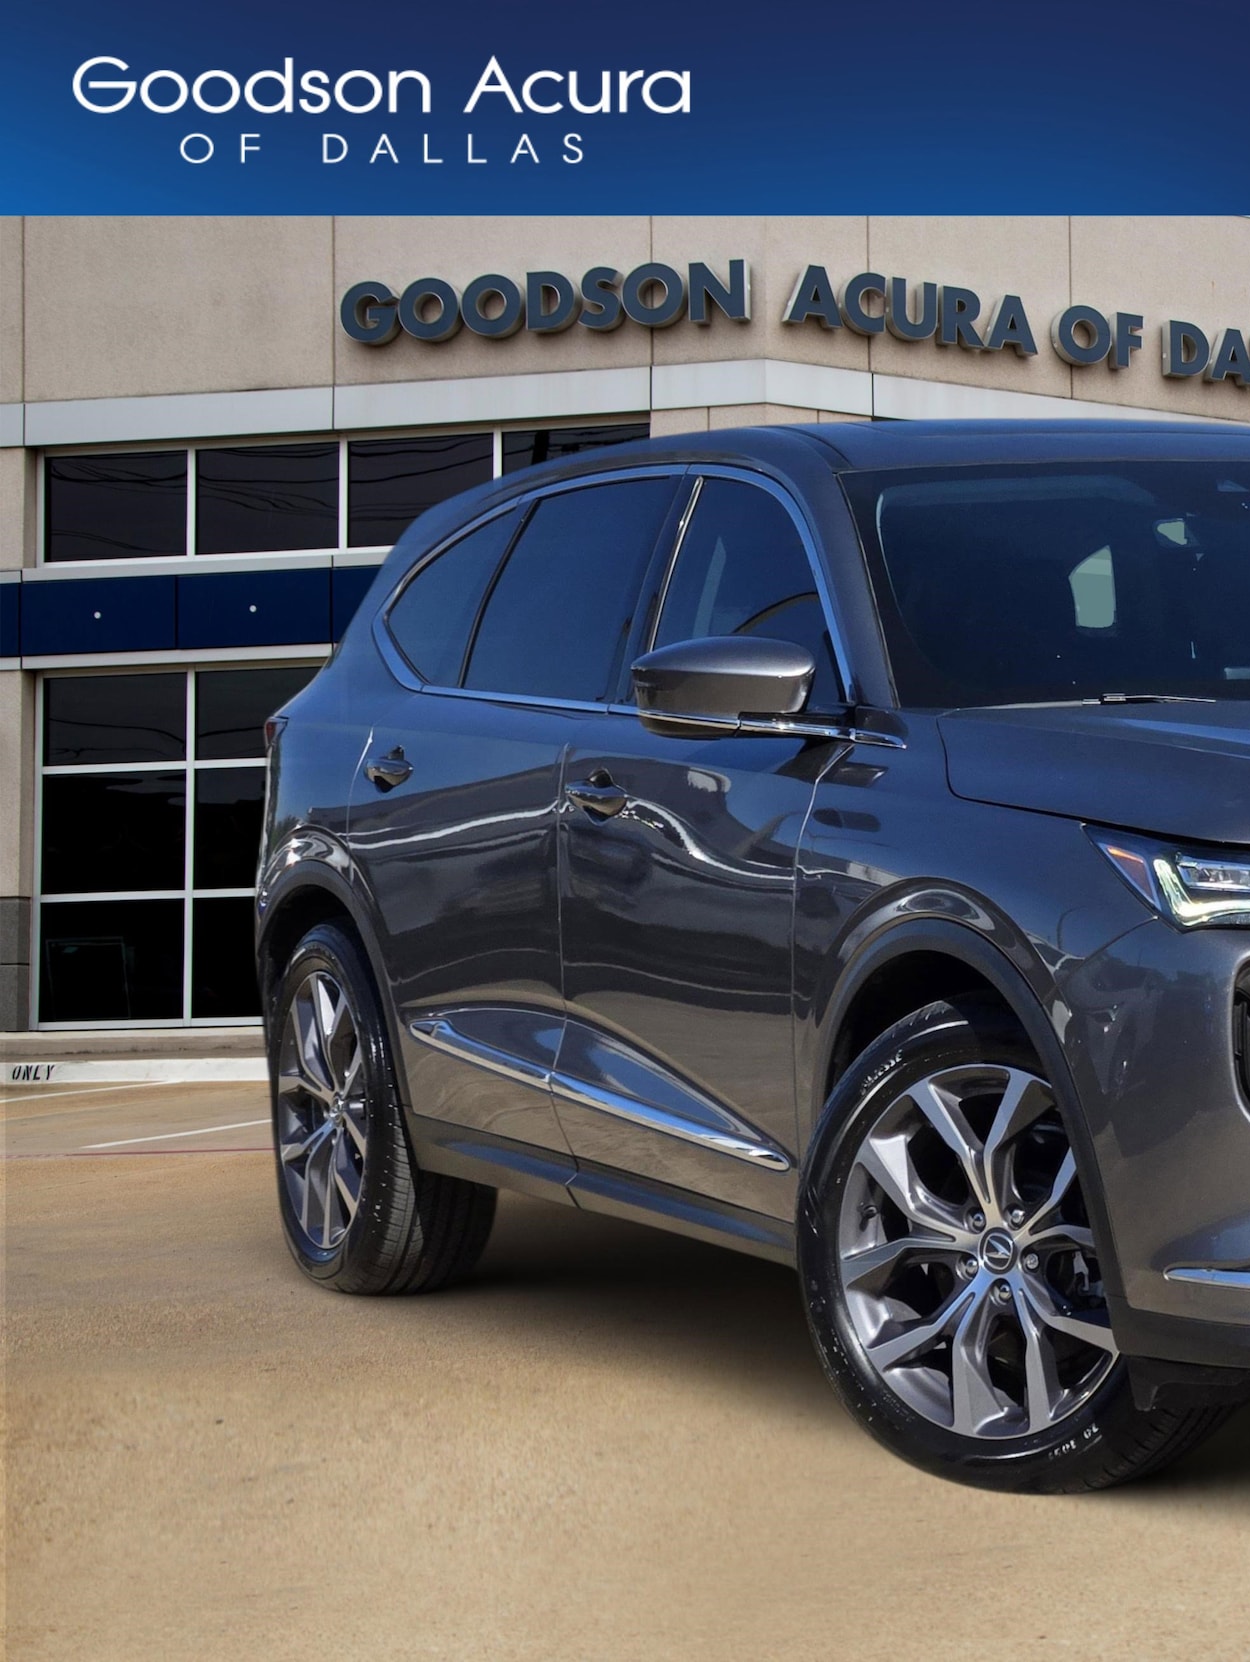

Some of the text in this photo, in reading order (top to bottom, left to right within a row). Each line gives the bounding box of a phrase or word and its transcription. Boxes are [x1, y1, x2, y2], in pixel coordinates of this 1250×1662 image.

[340, 258, 750, 344] GOODSON
[782, 264, 1038, 356] ACURA
[1051, 305, 1143, 370] OF
[12, 1064, 55, 1081] ONLY
